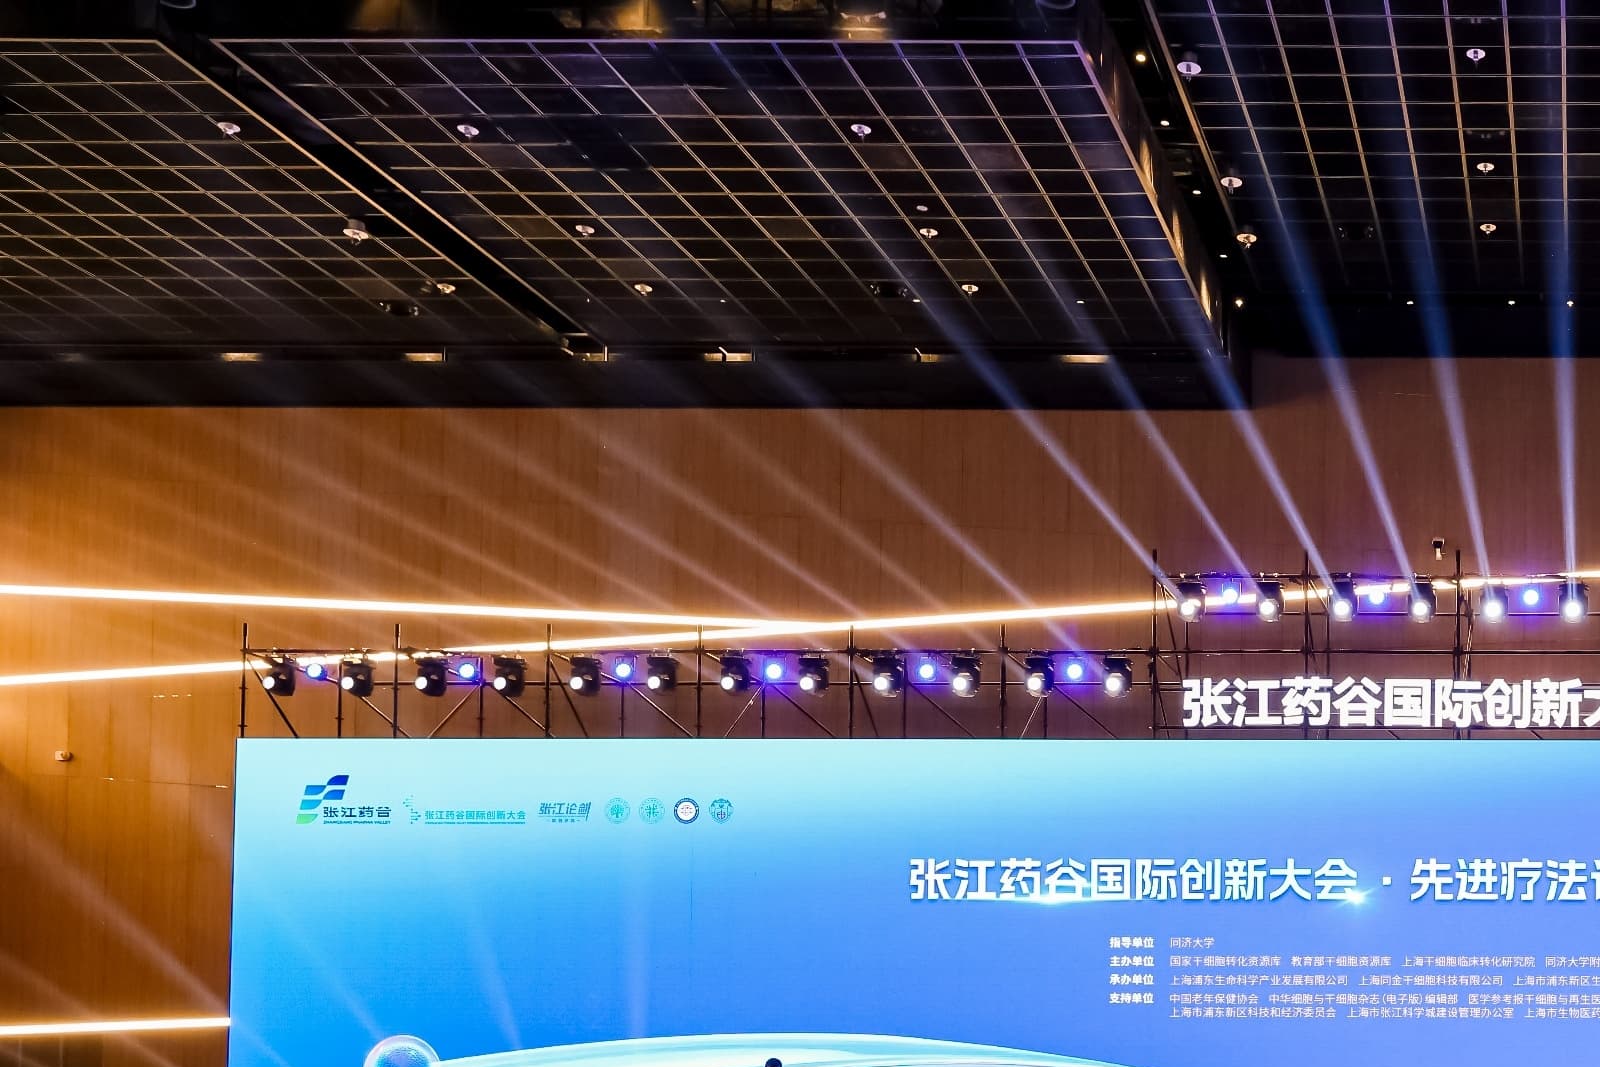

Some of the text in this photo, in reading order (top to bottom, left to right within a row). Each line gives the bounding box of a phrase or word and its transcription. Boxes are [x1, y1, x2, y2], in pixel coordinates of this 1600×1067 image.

[322, 806, 392, 818] 张江药谷
[424, 810, 526, 820] 张江药谷国际创新大会
[1109, 936, 1215, 949] 指导单位 同济大学
[1109, 955, 1155, 967] 主办单位
[1169, 955, 1281, 967] 国家干细胞转化资源库
[1290, 955, 1392, 967] 教育部干细胞资源库
[1401, 955, 1536, 968] 上海干细胞临床转化研究院
[1109, 973, 1155, 986] 承办单位
[1170, 974, 1348, 986] 上海浦东生命科学产业发展有限公司
[1109, 992, 1154, 1004] 支持单位
[1169, 993, 1259, 1005] 中国老年保健协会
[1170, 1006, 1336, 1018] 上海市浦东新区科技和经济委员会
[1346, 1006, 1514, 1019] 上海市张江科学城建设管理办公室
